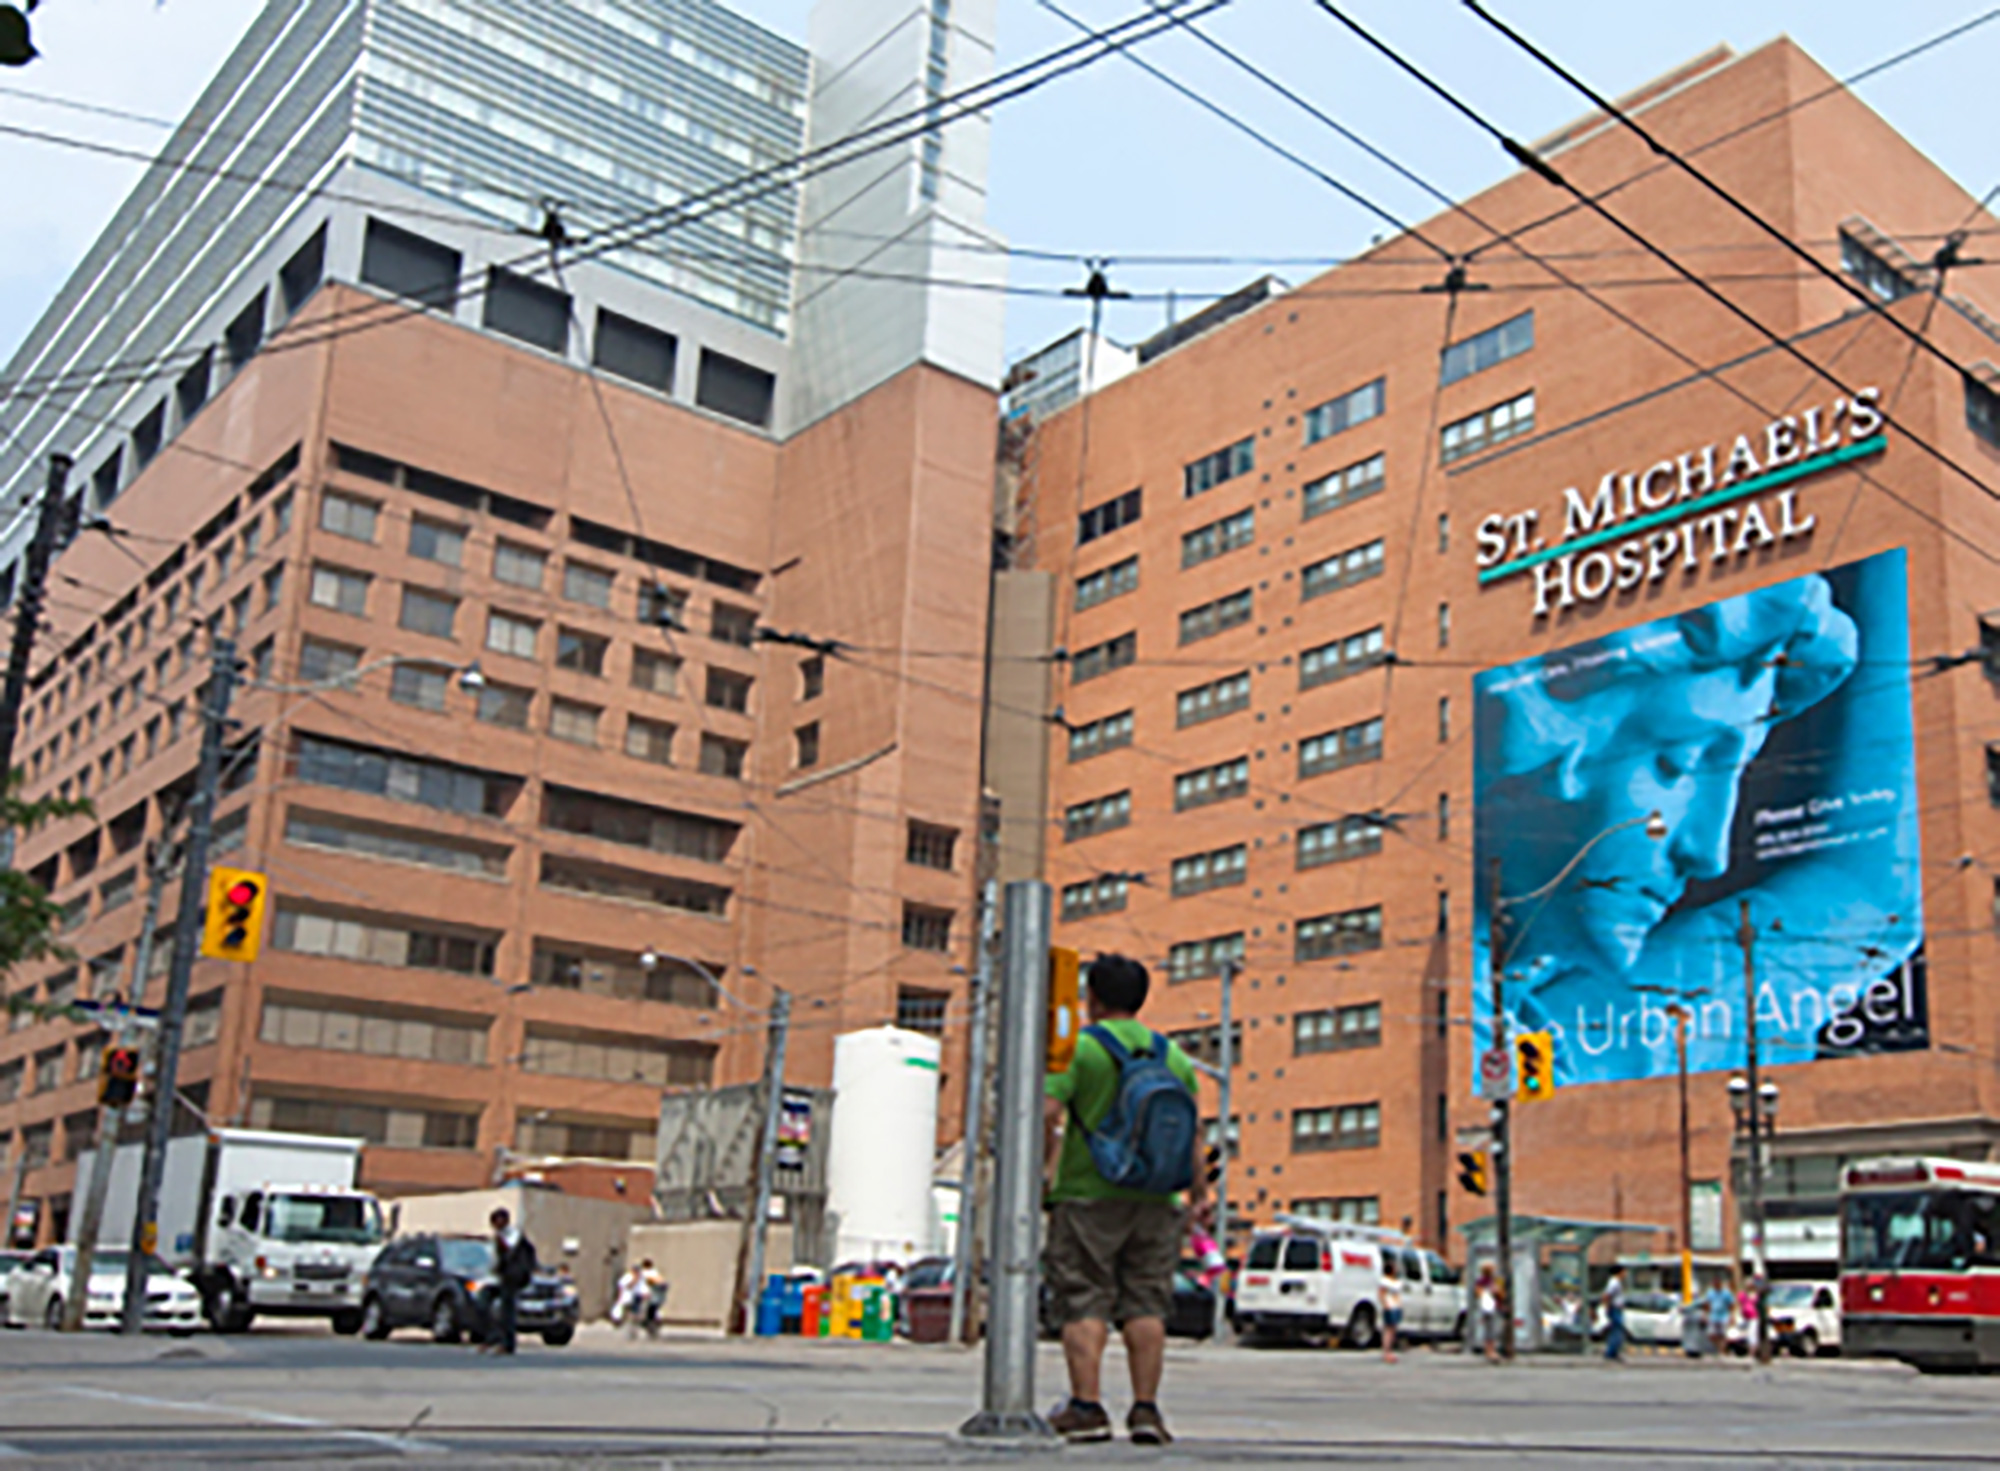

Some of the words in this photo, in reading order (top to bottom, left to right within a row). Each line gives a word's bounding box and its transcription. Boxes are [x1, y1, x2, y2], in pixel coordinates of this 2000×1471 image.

[1564, 387, 1884, 537] MICHAEL'S
[1532, 490, 1815, 618] HOSPITAL
[1576, 992, 1732, 1056] Urban
[1754, 960, 1914, 1046] Angel
